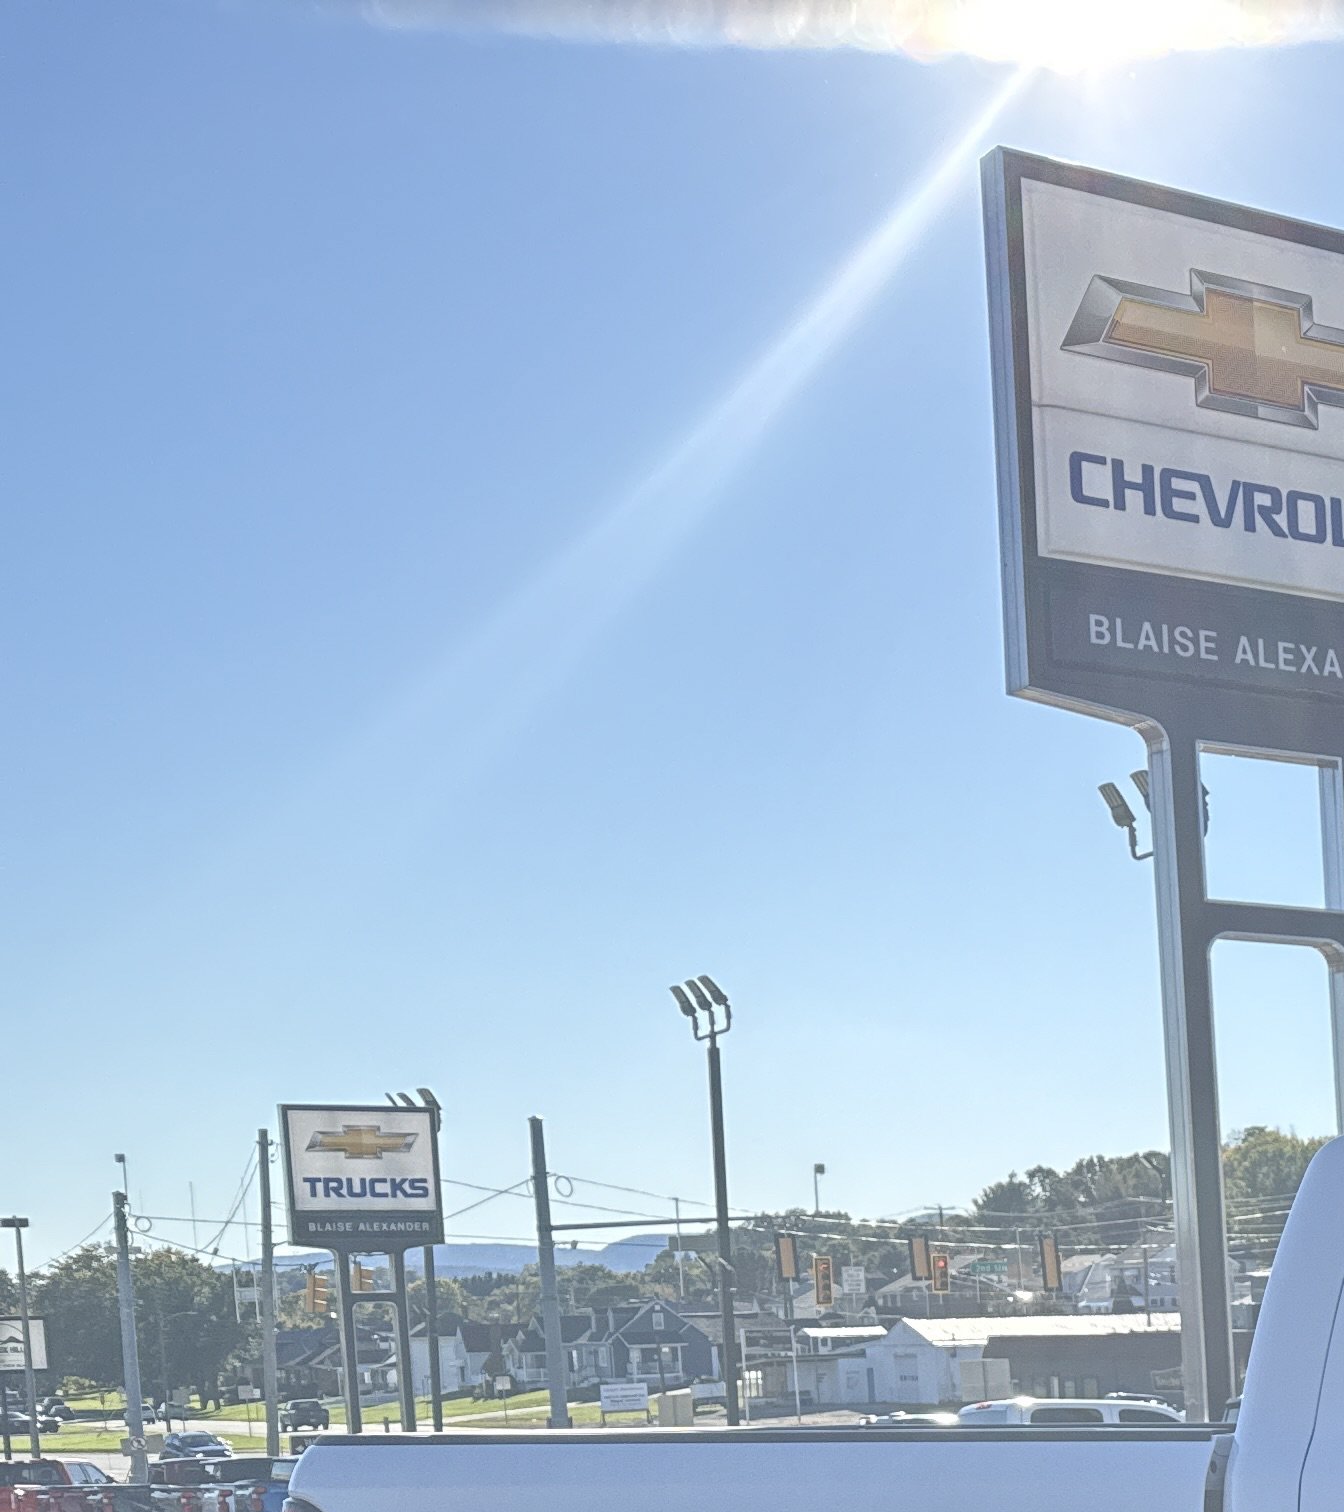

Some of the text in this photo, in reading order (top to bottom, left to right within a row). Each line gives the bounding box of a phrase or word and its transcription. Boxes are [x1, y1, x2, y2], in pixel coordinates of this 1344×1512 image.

[1089, 612, 1218, 662] BLAISE
[302, 1176, 430, 1199] TRUCKS
[308, 1221, 430, 1232] BLAISE ALEXANDER
